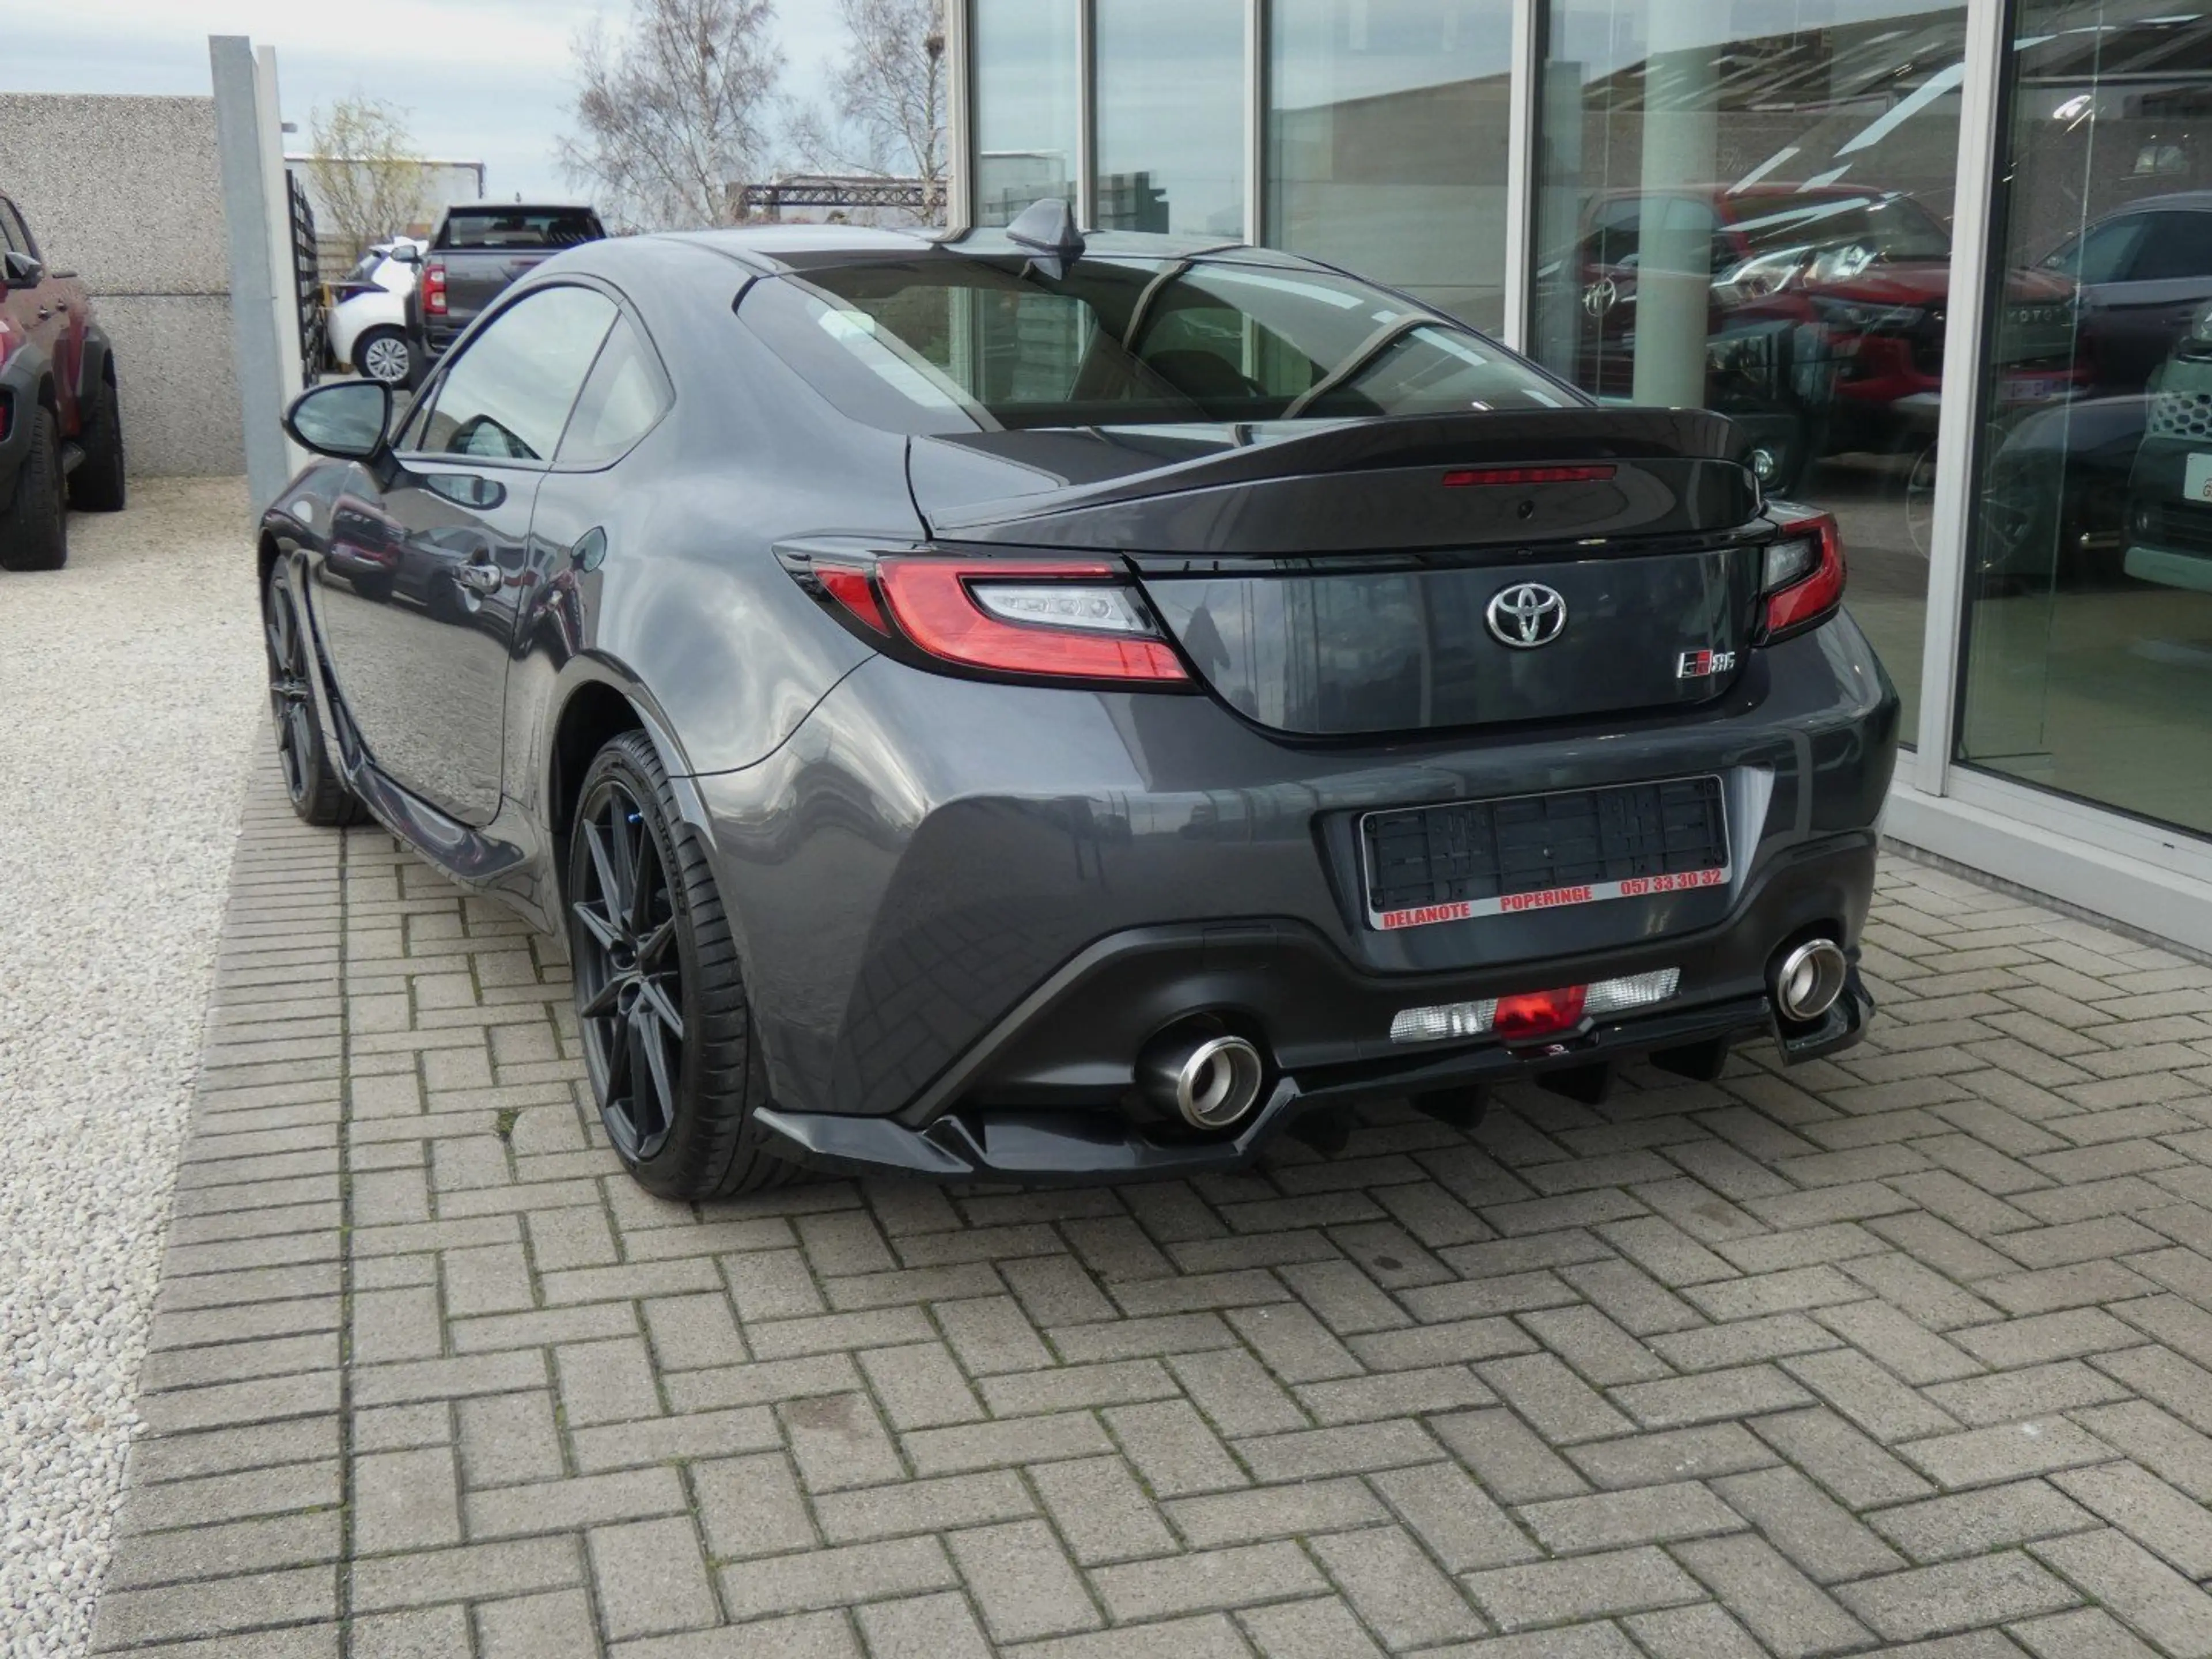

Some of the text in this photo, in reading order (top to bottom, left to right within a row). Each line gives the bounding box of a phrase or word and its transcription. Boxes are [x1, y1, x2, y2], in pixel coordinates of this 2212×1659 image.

[1382, 869, 1721, 928] DELANOTE POPERINGE 057 33 30 32
